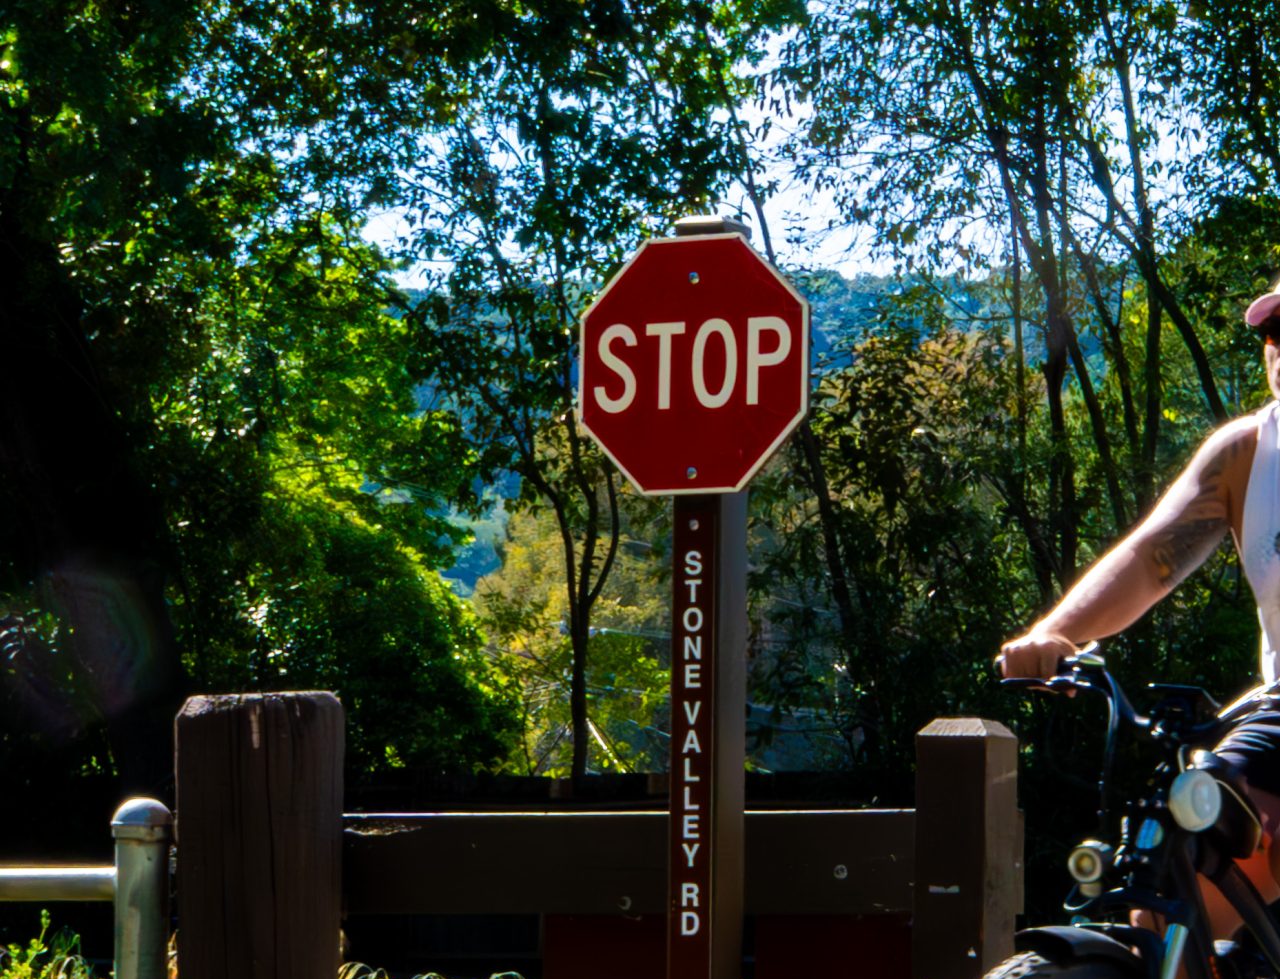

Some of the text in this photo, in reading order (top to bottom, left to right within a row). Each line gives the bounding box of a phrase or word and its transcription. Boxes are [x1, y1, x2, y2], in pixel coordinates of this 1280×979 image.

[593, 315, 792, 414] STOP
[680, 550, 703, 936] STONE VALLEY RD
